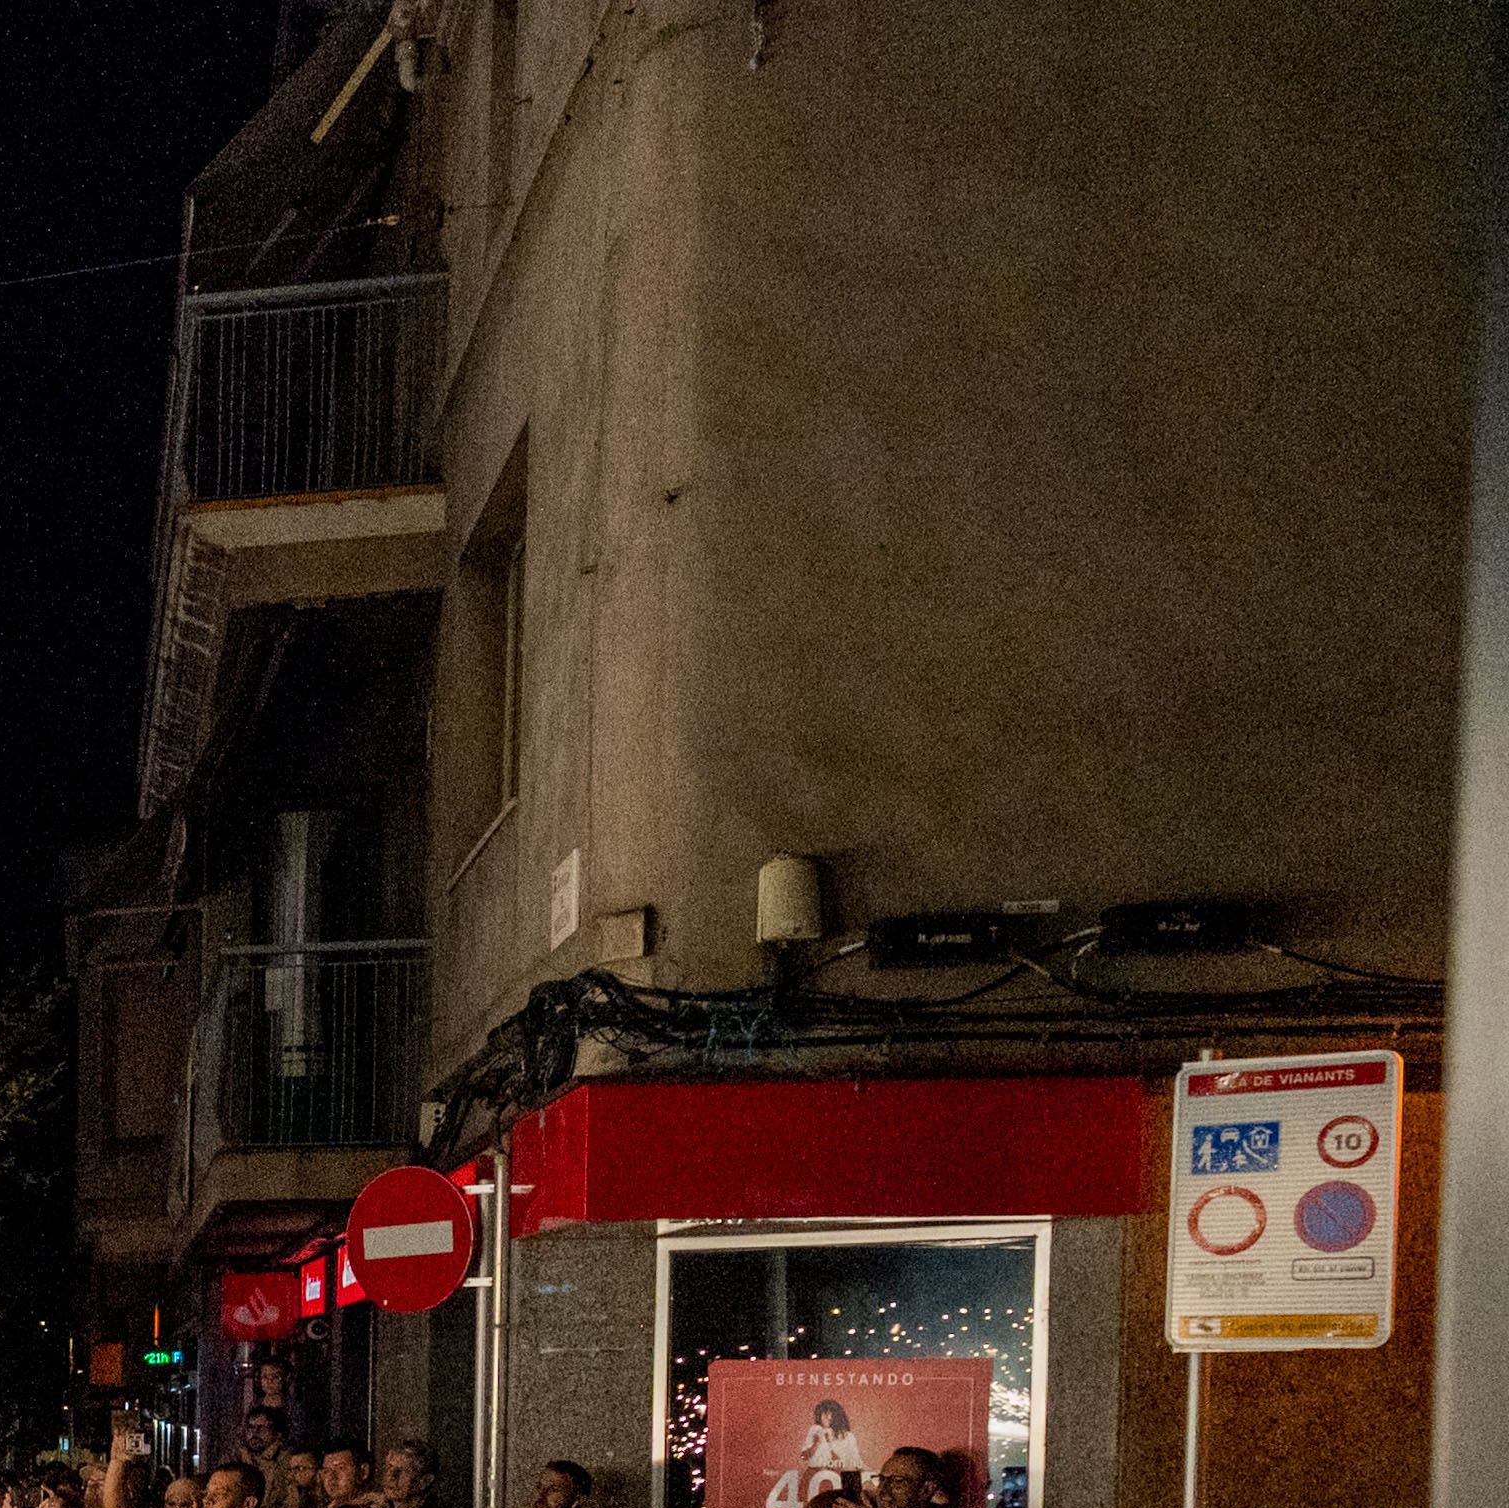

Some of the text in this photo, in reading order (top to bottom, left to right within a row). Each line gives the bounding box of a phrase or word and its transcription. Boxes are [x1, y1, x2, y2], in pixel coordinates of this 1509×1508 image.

[1253, 1074, 1273, 1087] DE
[1279, 1068, 1355, 1086] VIANANTS
[1333, 1133, 1362, 1151] 10
[776, 1372, 914, 1386] BIENESTANDO
